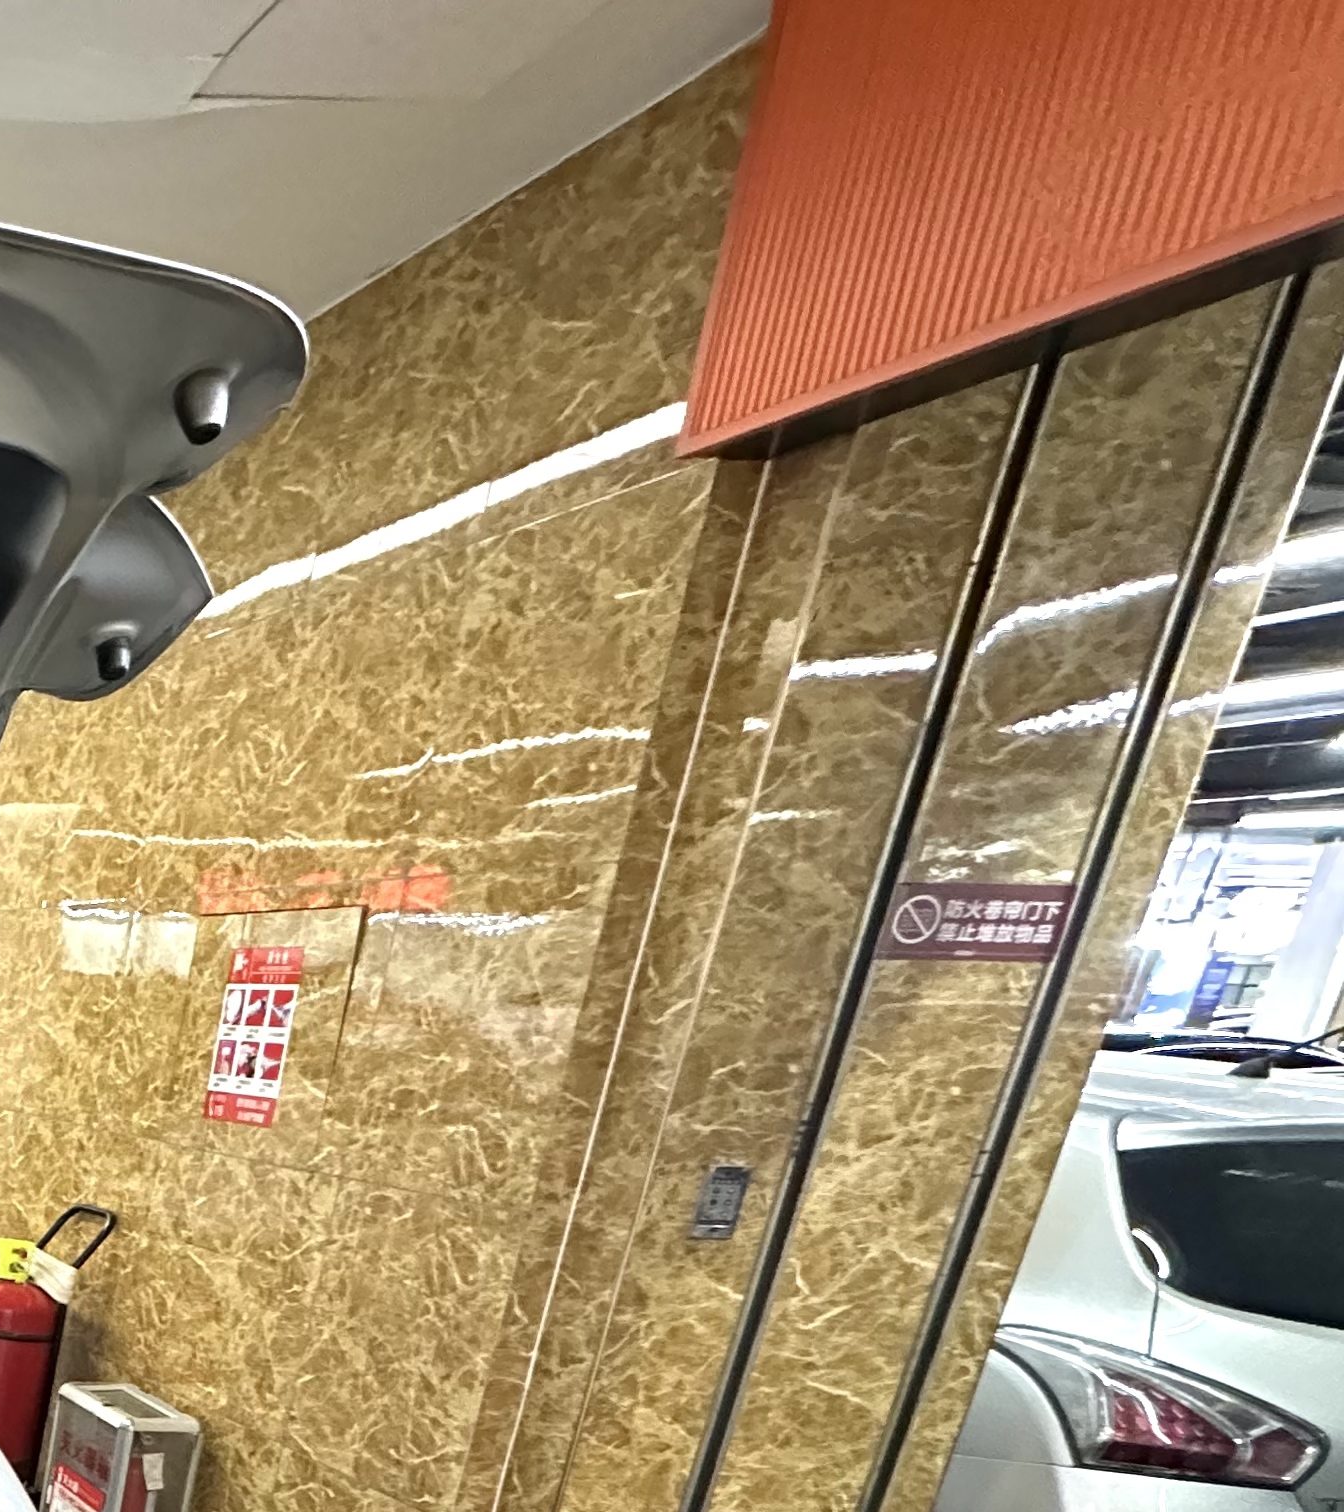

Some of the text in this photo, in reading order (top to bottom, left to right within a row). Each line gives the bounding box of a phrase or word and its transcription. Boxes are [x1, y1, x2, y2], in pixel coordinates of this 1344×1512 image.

[943, 900, 1064, 921] 防火卷帘门下
[935, 922, 1055, 943] 禁止堆放物品
